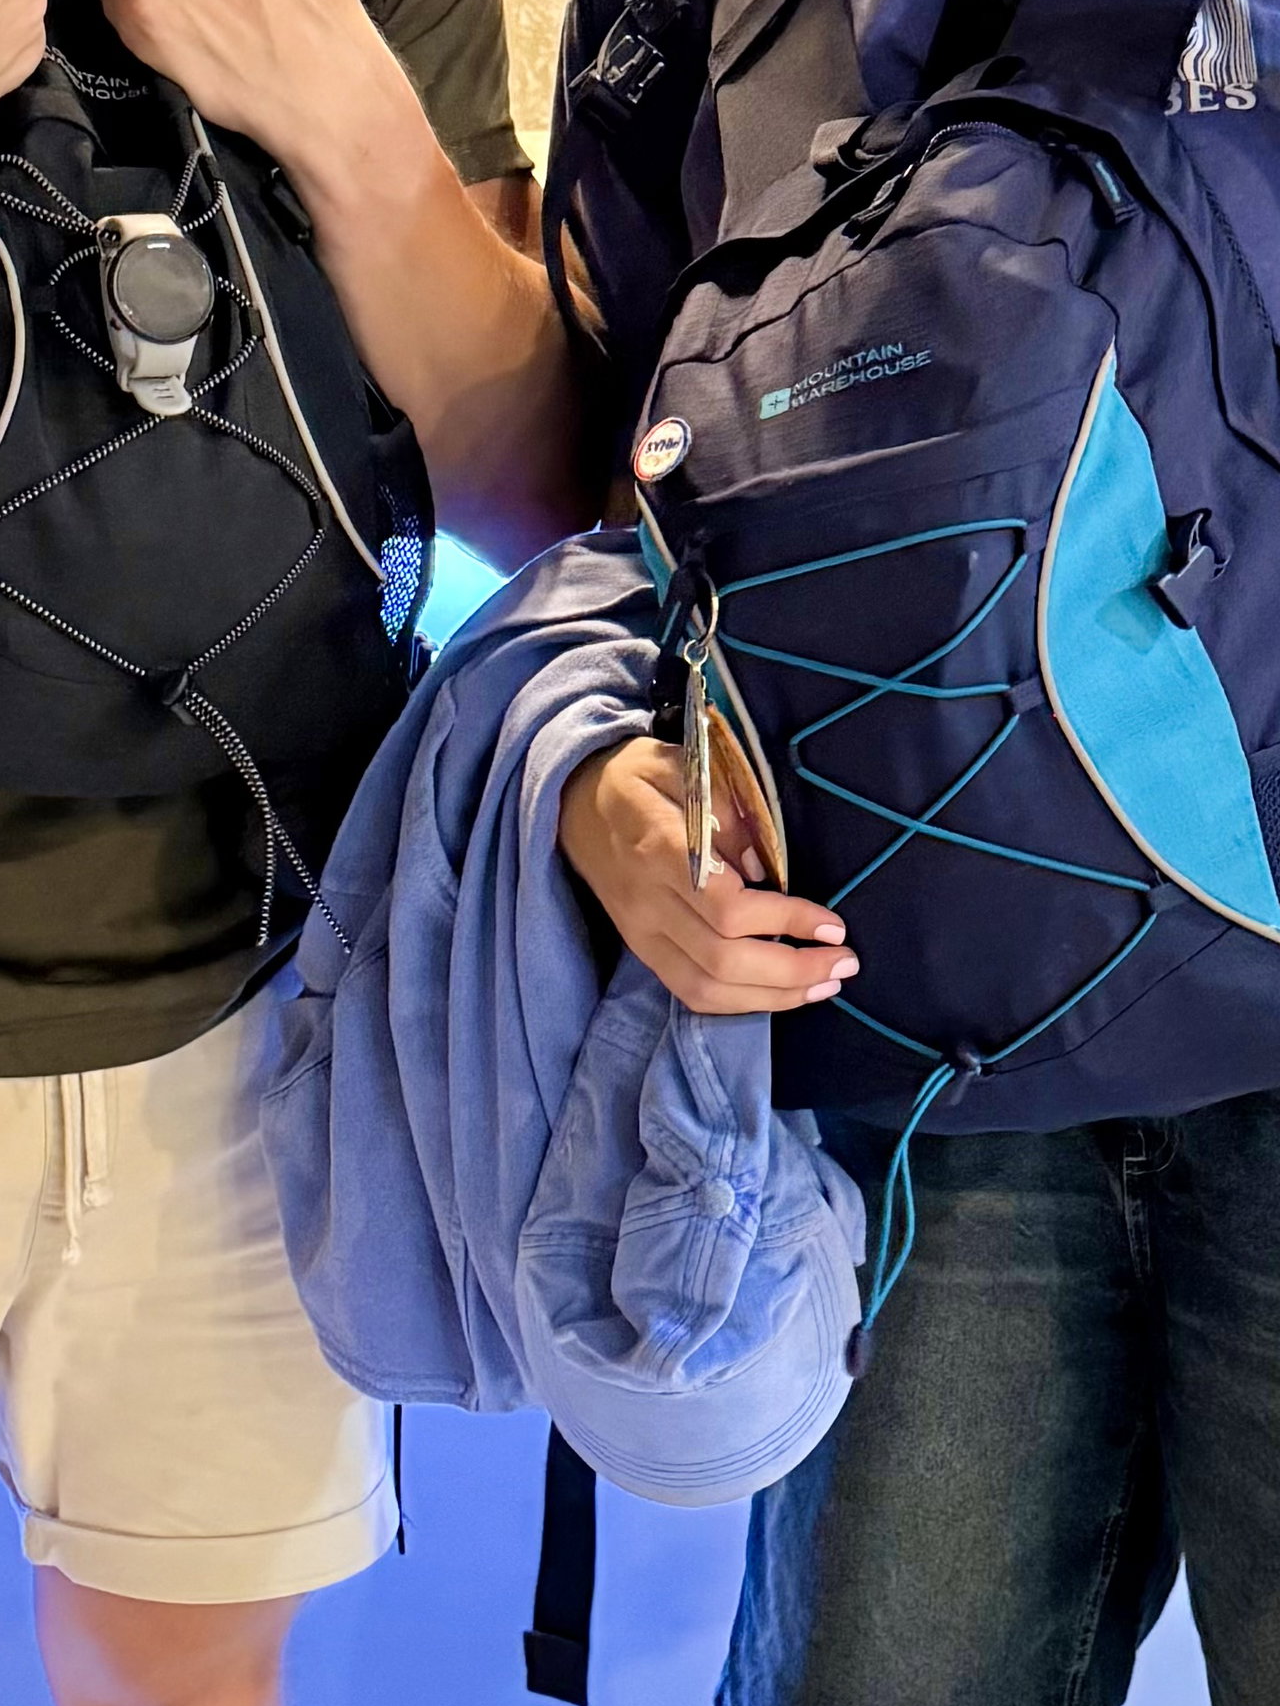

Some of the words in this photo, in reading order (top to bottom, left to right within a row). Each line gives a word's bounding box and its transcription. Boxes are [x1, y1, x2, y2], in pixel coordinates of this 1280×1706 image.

[45, 45, 130, 88] TAIN
[791, 350, 932, 408] WAREHOUSE
[792, 342, 904, 394] MOUNTAIN
